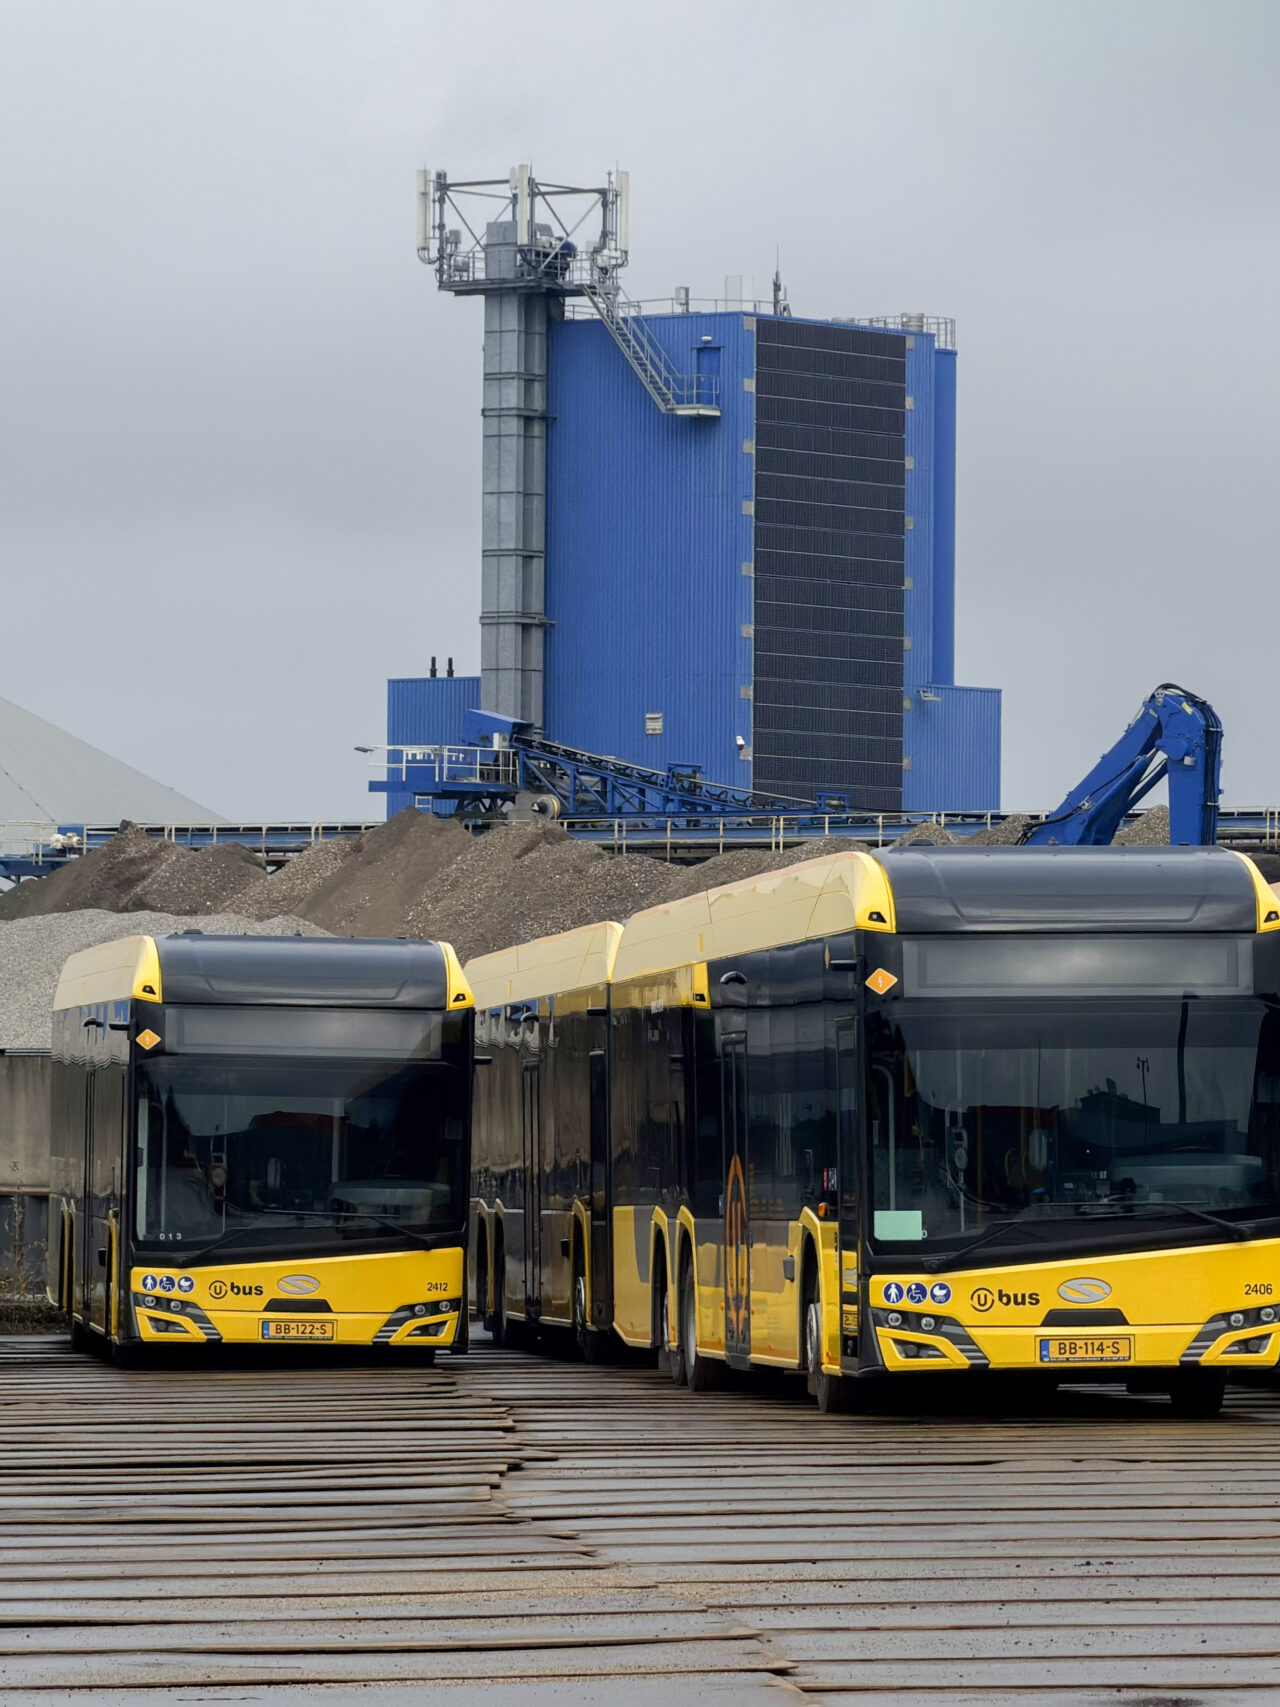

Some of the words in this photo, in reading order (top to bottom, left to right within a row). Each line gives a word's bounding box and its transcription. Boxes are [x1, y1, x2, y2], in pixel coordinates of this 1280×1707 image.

[230, 1282, 264, 1296] bus
[427, 1282, 448, 1292] 2412
[1244, 1283, 1273, 1296] 2406
[997, 1288, 1041, 1307] bus
[275, 1323, 327, 1335] BB-122-S
[1058, 1341, 1120, 1355] BB-114-S
